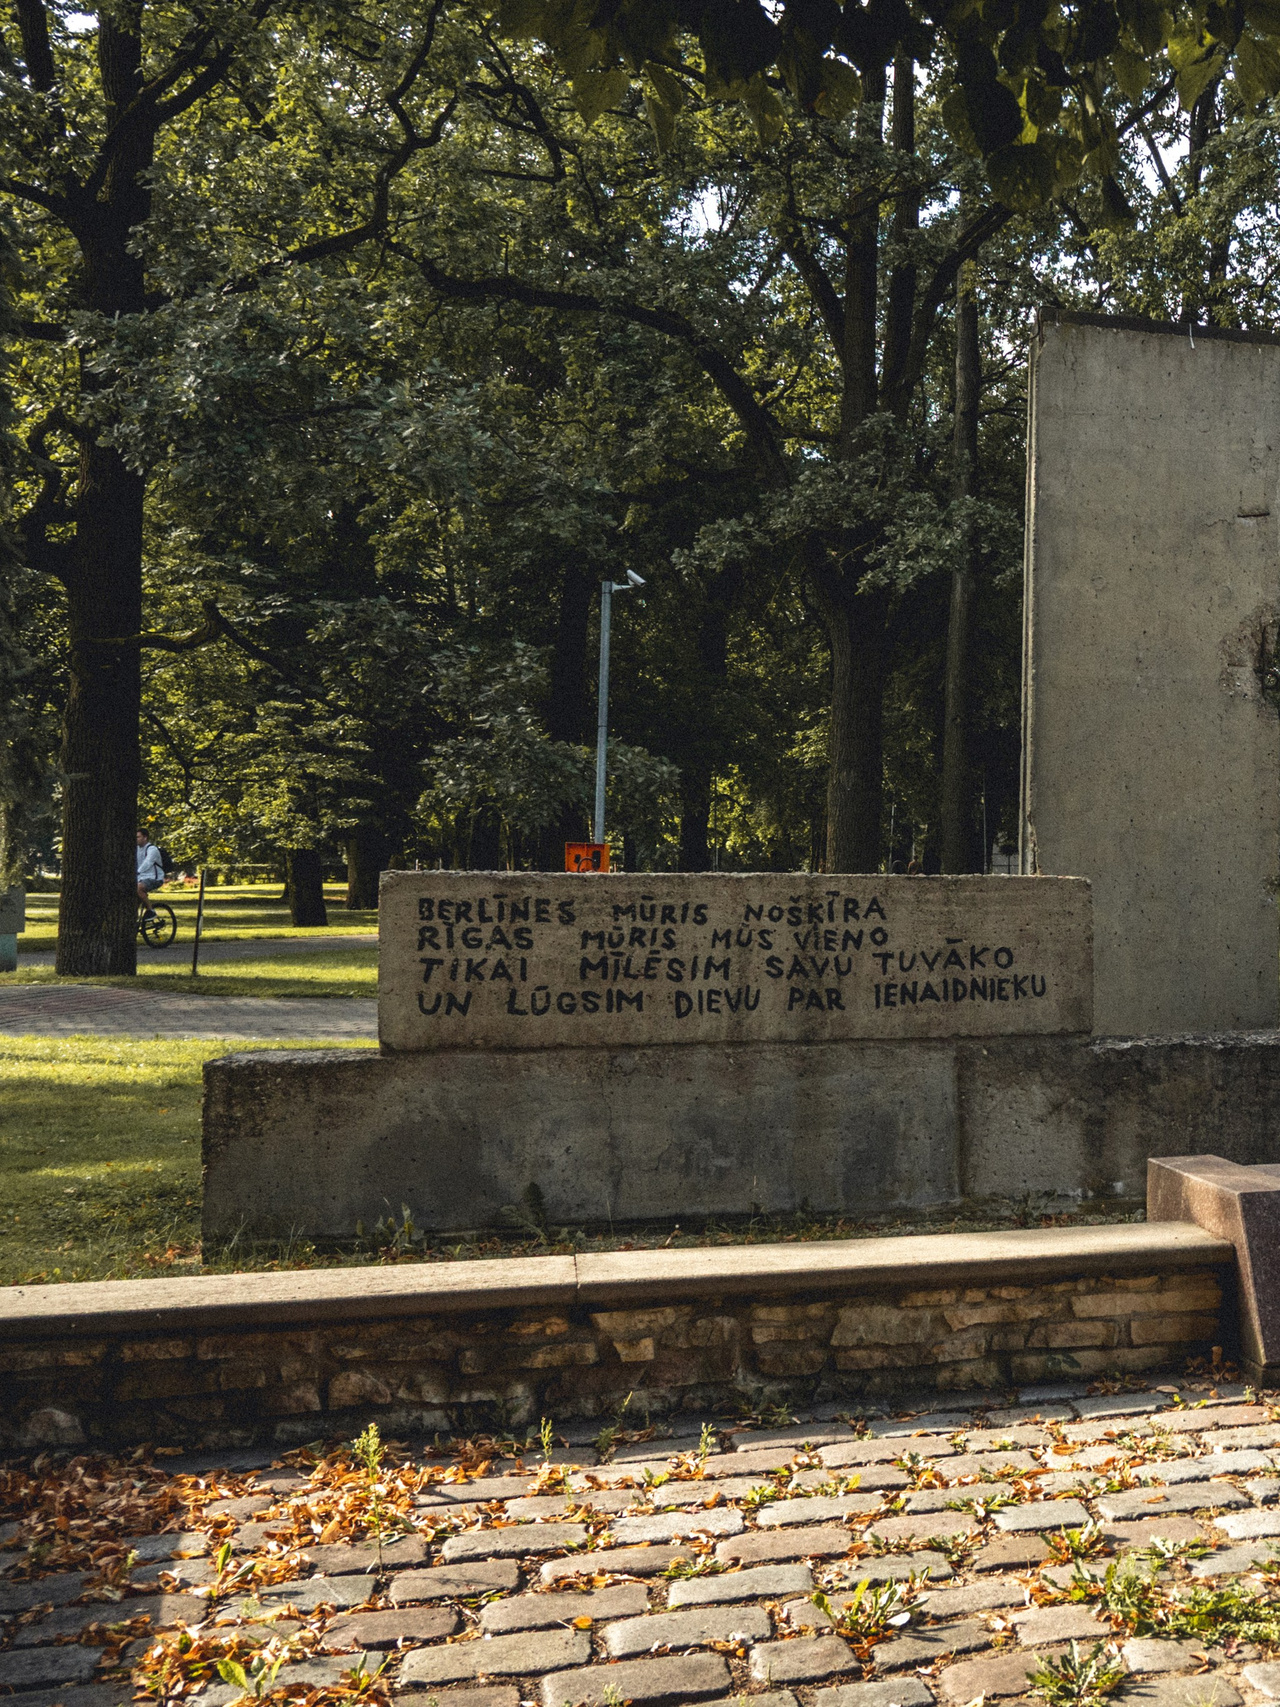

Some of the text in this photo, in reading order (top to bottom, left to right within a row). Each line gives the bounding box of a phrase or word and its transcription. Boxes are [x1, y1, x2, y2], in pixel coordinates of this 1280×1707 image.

[418, 893, 577, 925] BERLĪNES
[613, 895, 708, 925] MŪRIS
[417, 920, 889, 951] RĪGAS MŪRIS MŪS VIENO
[419, 938, 1014, 983] TIKAI MĪLĒSIM SAVU TUVĀKO
[417, 974, 1047, 1019] UN LŪGSIM DIEVU PAR IENAIDNIEKU
